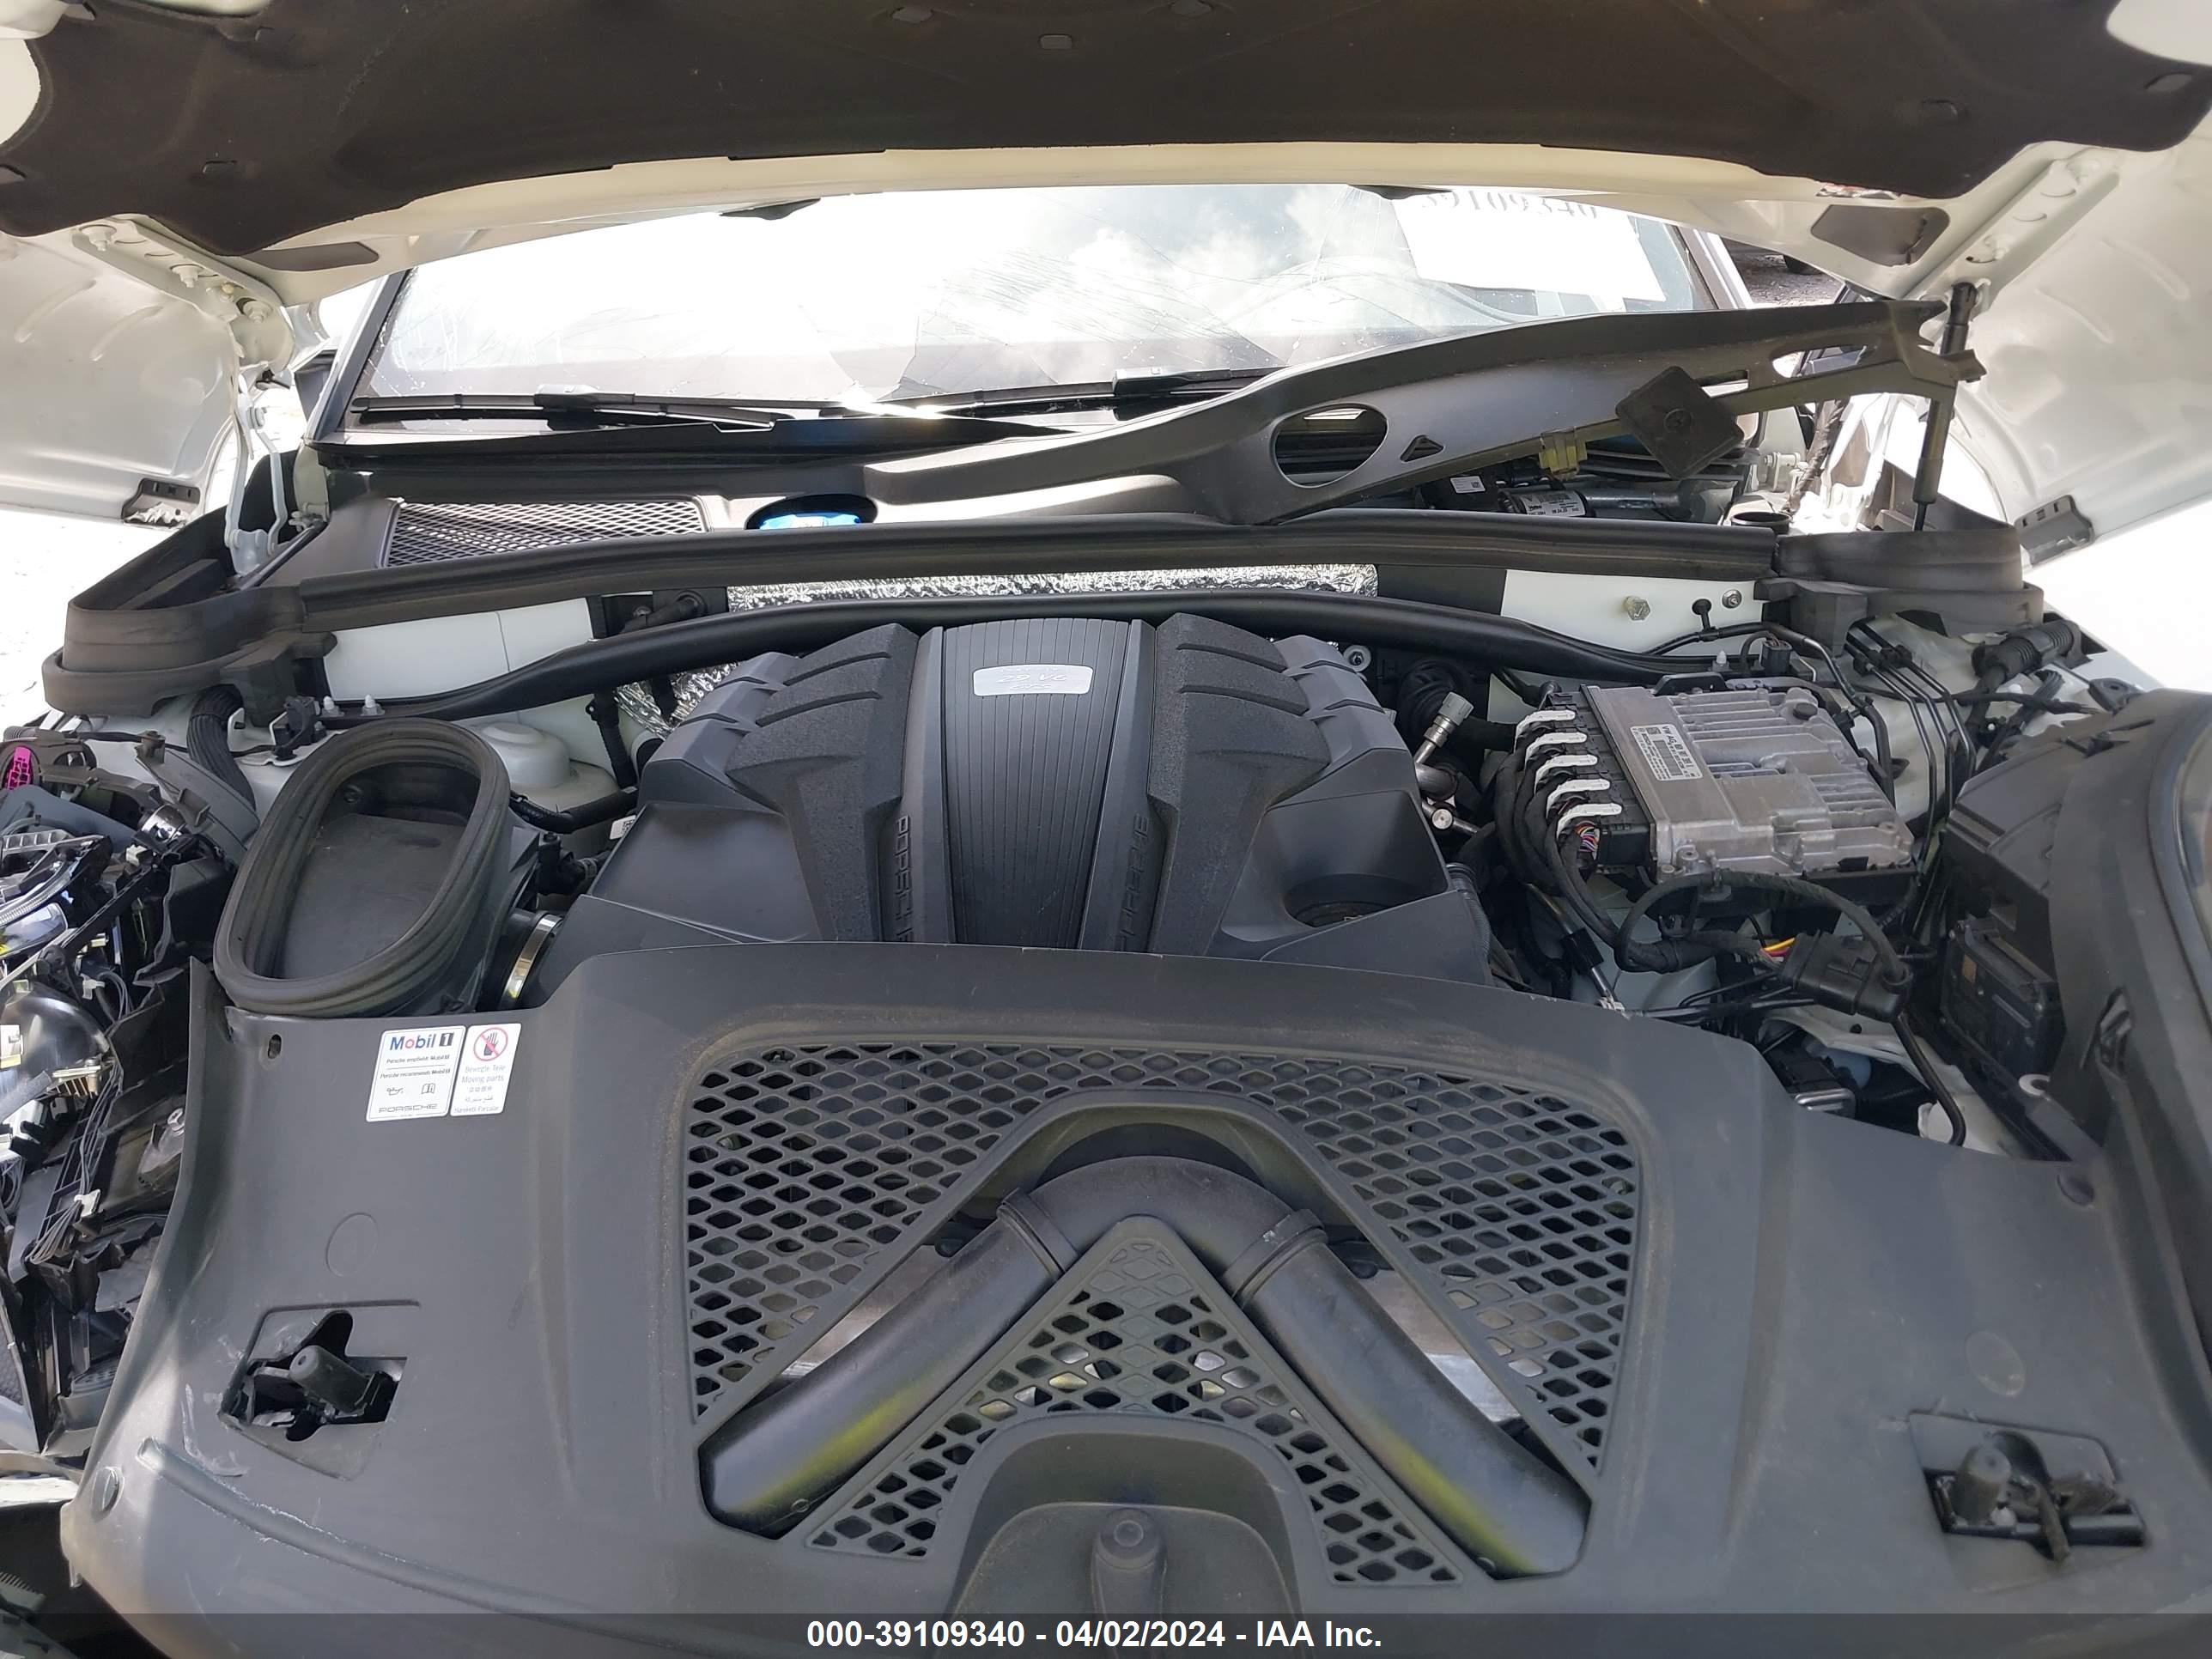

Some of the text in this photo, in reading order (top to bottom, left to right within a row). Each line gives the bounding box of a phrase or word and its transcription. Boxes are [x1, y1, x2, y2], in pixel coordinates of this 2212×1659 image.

[389, 1032, 454, 1051] Mobil 1
[378, 1103, 438, 1114] PORSCHE
